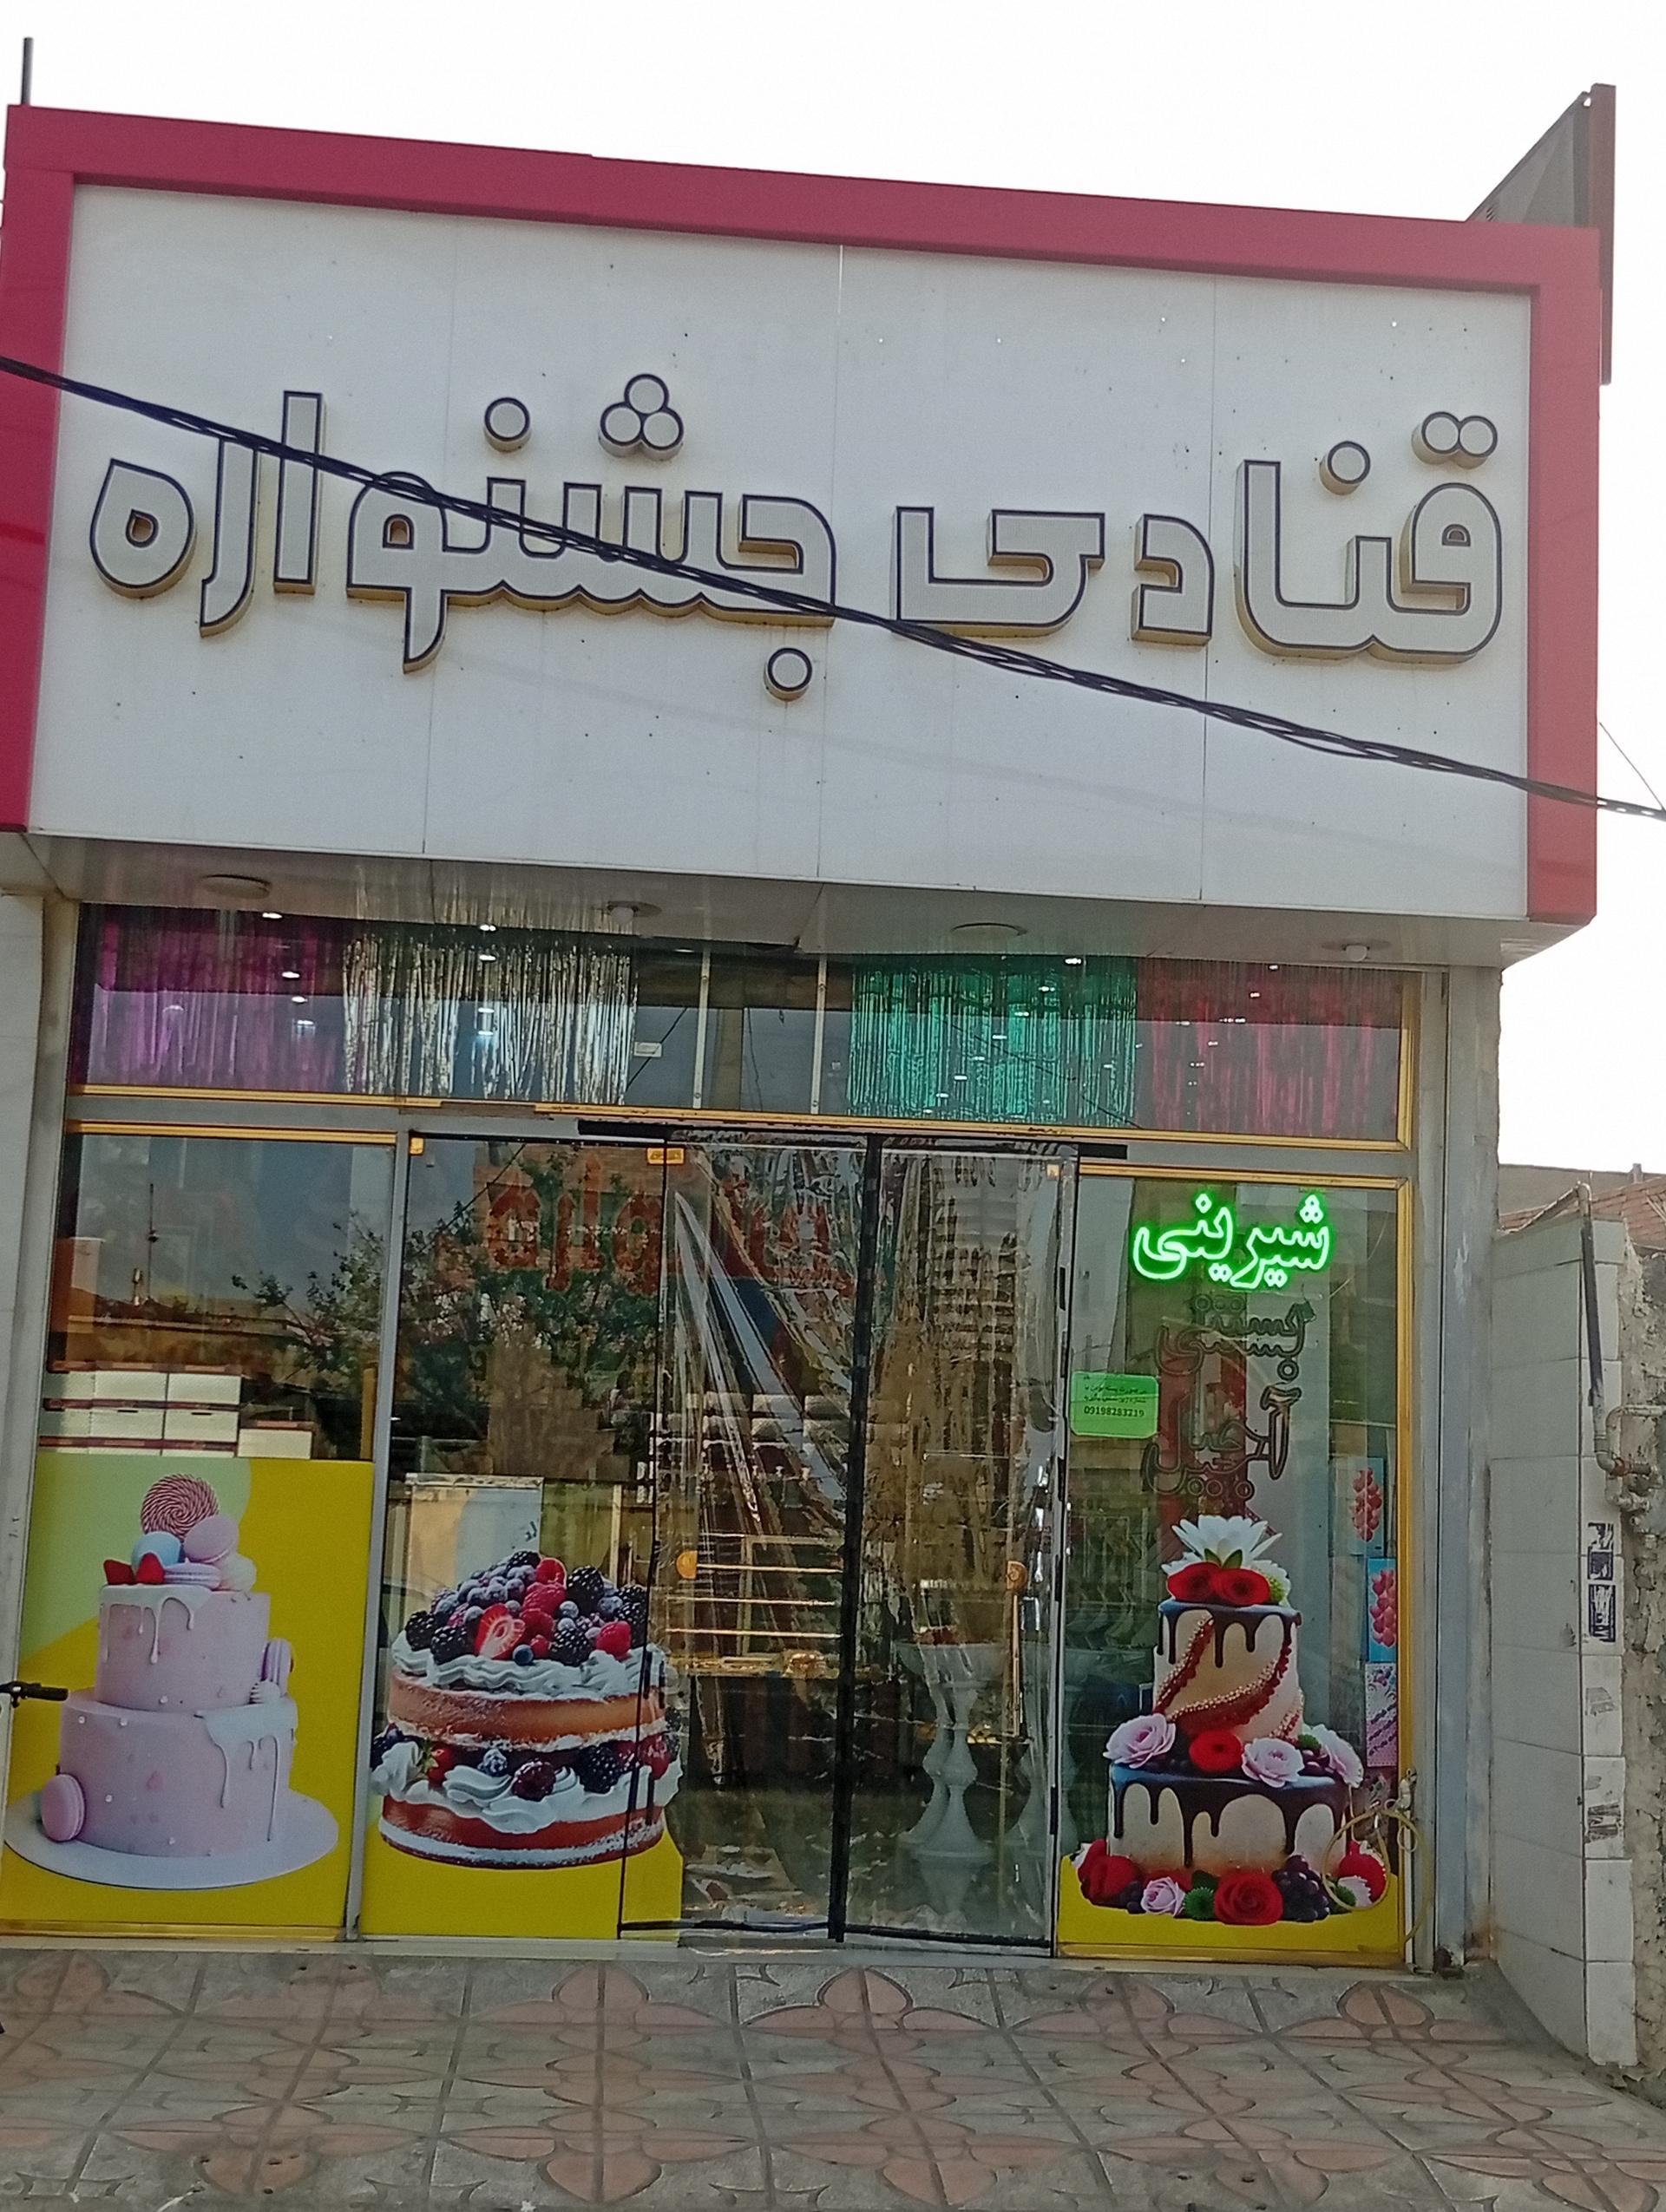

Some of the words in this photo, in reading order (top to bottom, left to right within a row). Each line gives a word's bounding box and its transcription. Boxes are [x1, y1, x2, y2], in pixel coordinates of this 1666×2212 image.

[89, 372, 836, 701] جشنواره
[895, 409, 1502, 664] قنادی
[1132, 1192, 1330, 1289] شیرینی
[1155, 1293, 1309, 1383] بستنی
[1141, 1380, 1303, 1501] آجیل
